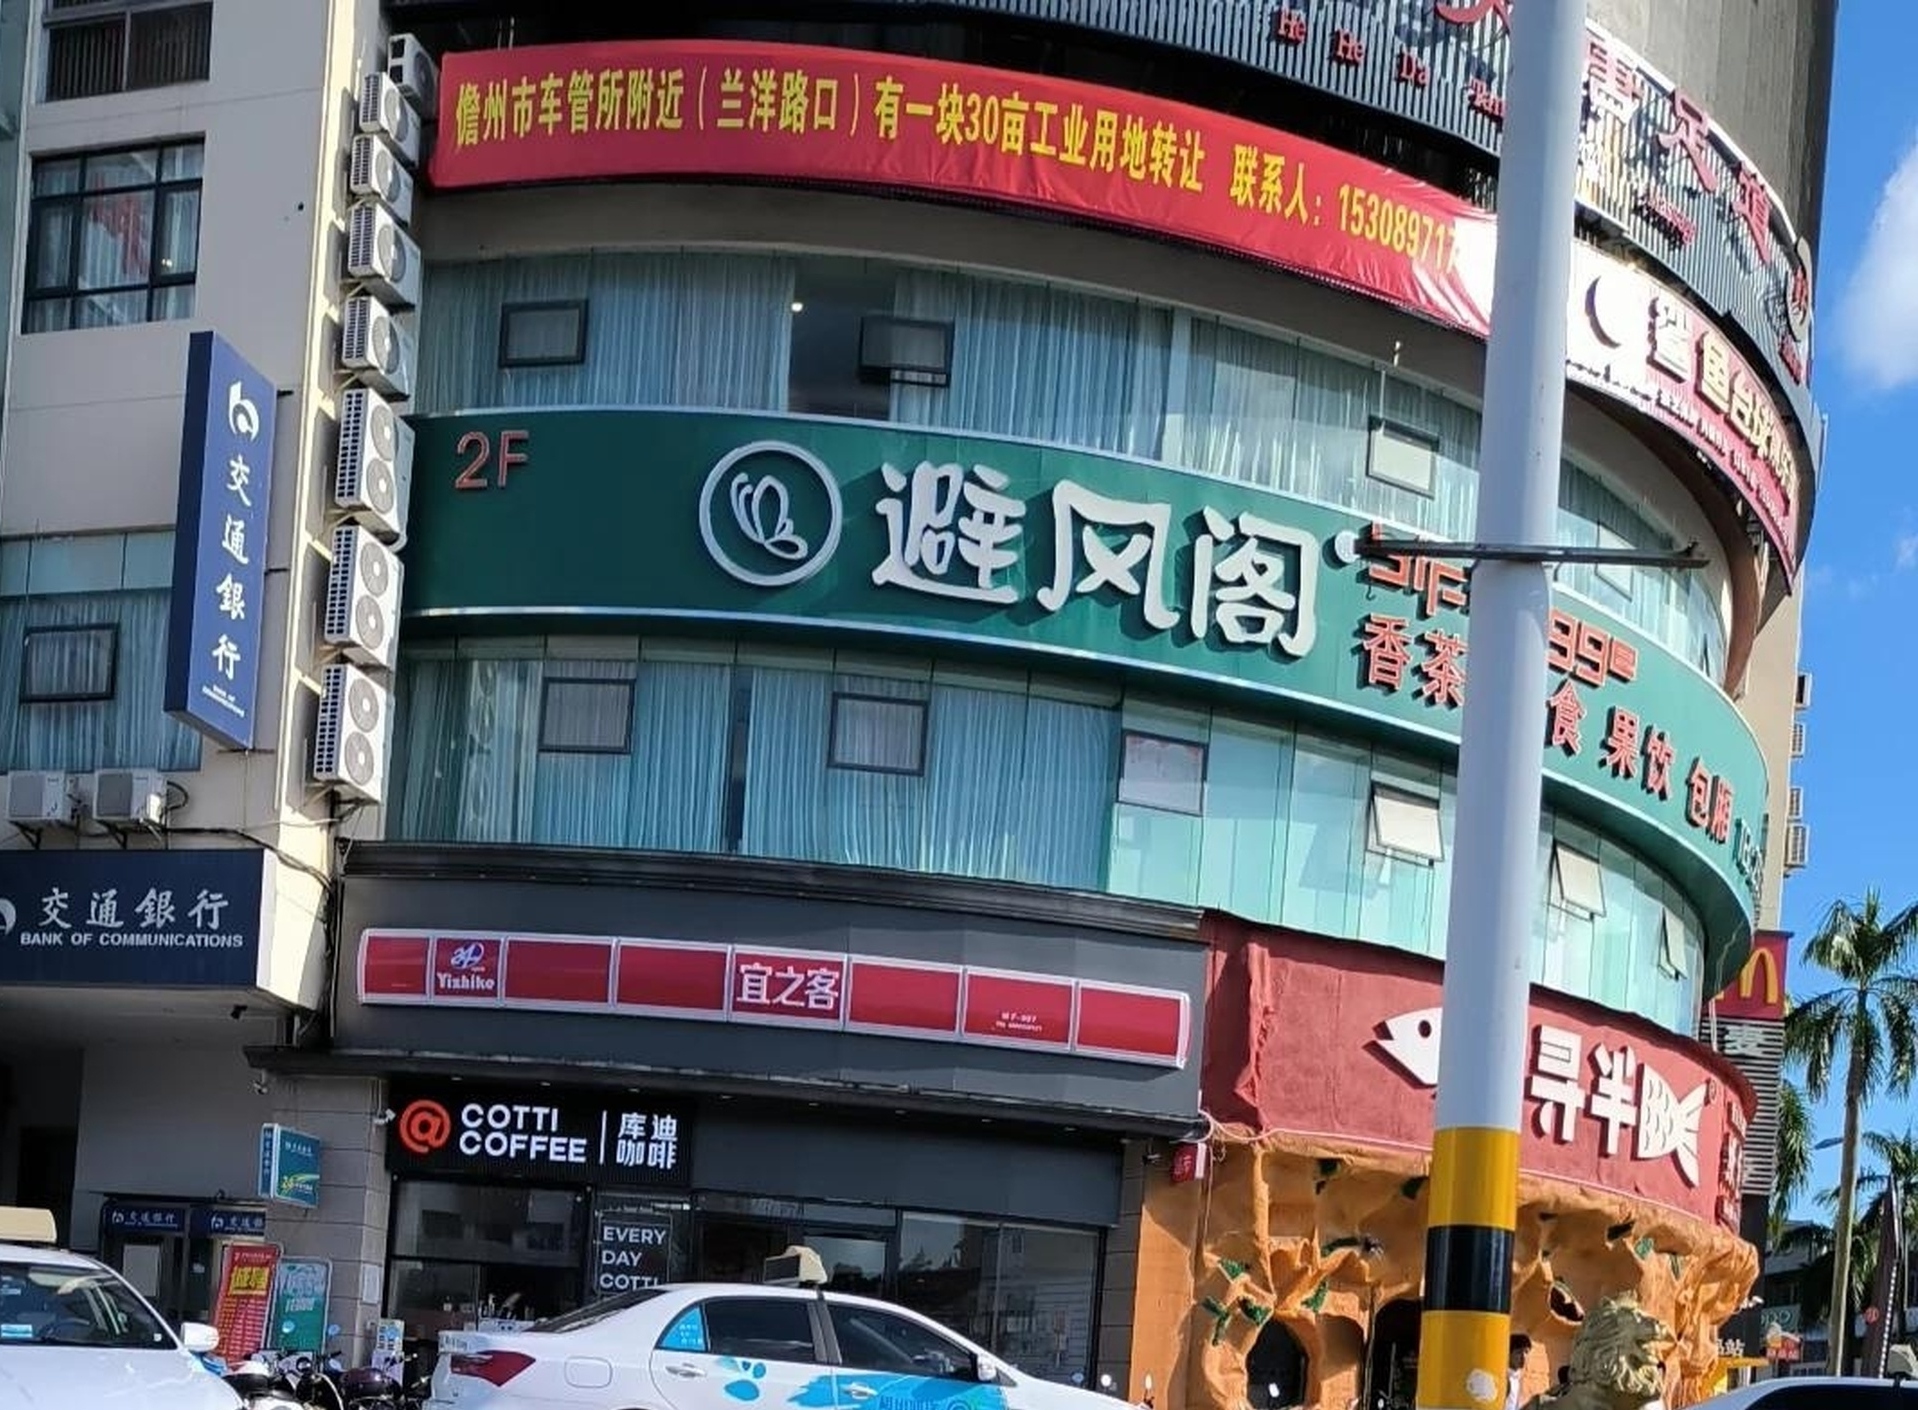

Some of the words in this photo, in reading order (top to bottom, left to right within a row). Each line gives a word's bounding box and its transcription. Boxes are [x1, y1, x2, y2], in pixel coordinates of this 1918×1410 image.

[455, 430, 529, 489] 2F
[871, 460, 1320, 658] 避风阁
[1364, 613, 1468, 706] 香茶
[1550, 679, 1587, 755] 食
[1606, 705, 1676, 800] 果饮
[38, 887, 229, 930] 交通銀行
[20, 932, 63, 946] BANK
[71, 932, 92, 946] OF
[99, 932, 244, 948] COMMUNICATIONS
[736, 962, 840, 1011] 宜之客
[461, 1102, 559, 1132] COTTI
[617, 1112, 678, 1142] 库迪
[459, 1130, 588, 1163] COFFEE
[616, 1139, 678, 1170] 咖啡
[603, 1226, 666, 1245] EVERY
[602, 1249, 643, 1267] DAY
